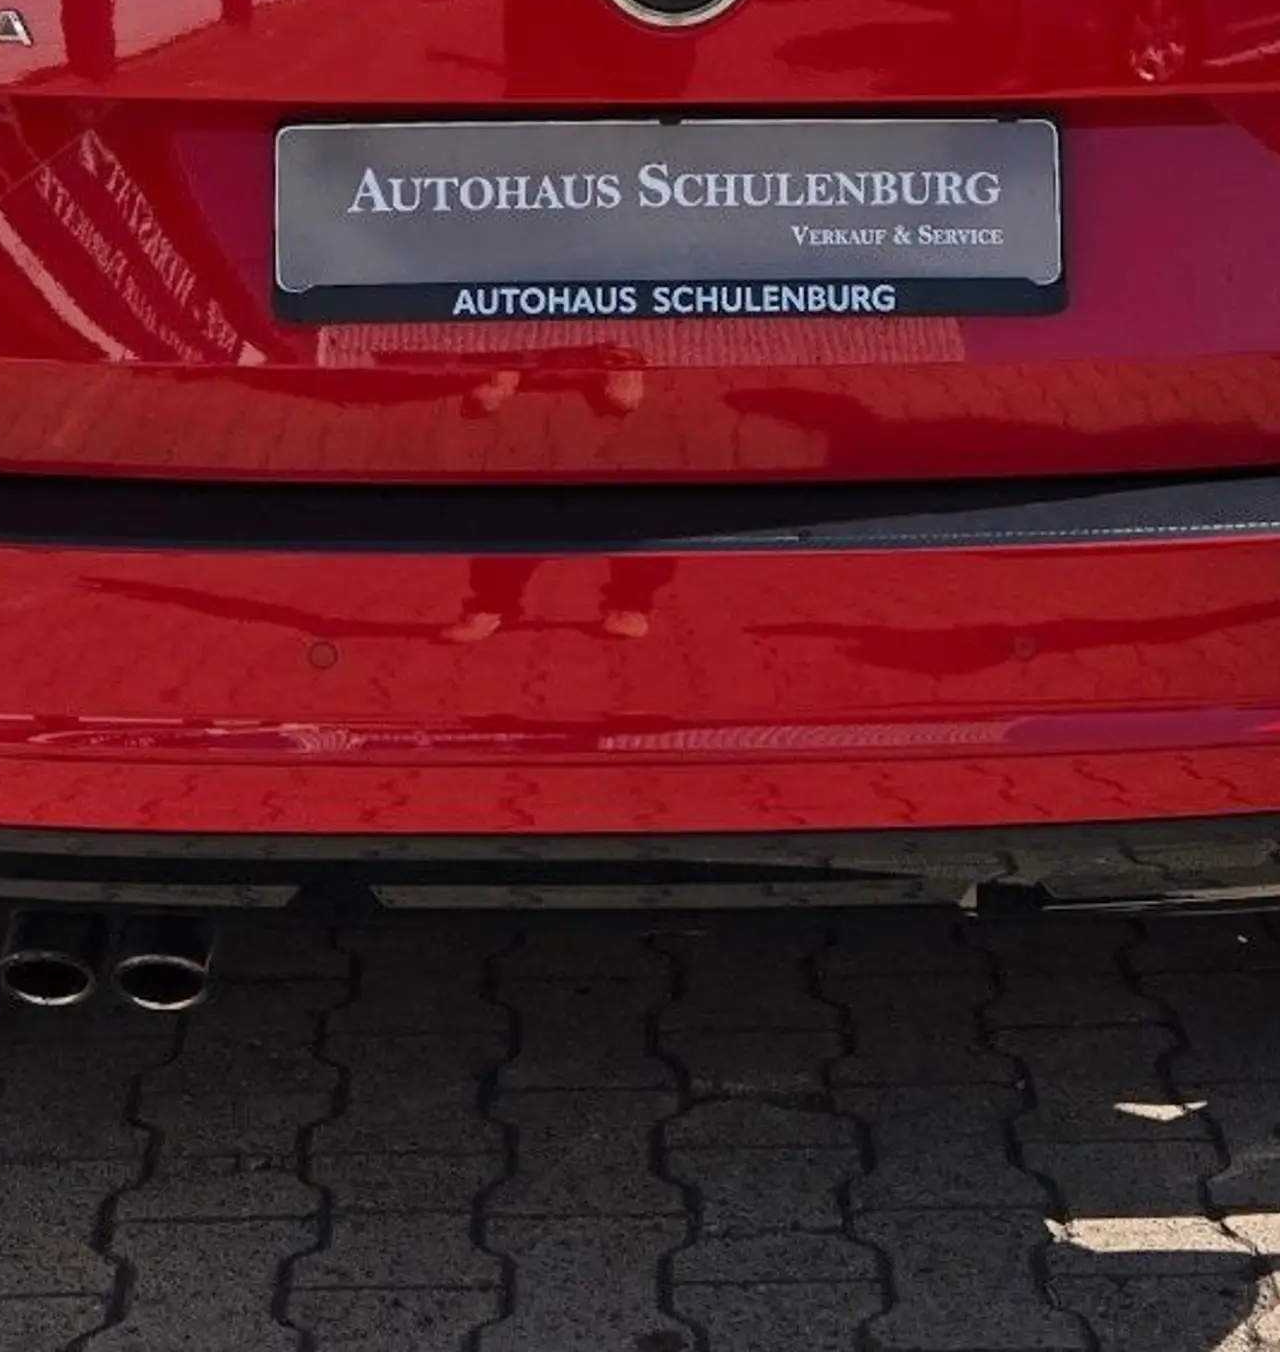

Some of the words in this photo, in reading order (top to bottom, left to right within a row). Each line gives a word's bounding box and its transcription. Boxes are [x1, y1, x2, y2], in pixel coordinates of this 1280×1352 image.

[347, 167, 623, 214] AUTOHAUS
[638, 162, 1002, 208] SCHULENBURG
[893, 225, 911, 245] &
[452, 285, 636, 316] AUTOHAUS
[652, 284, 896, 313] SCHULENBURG
